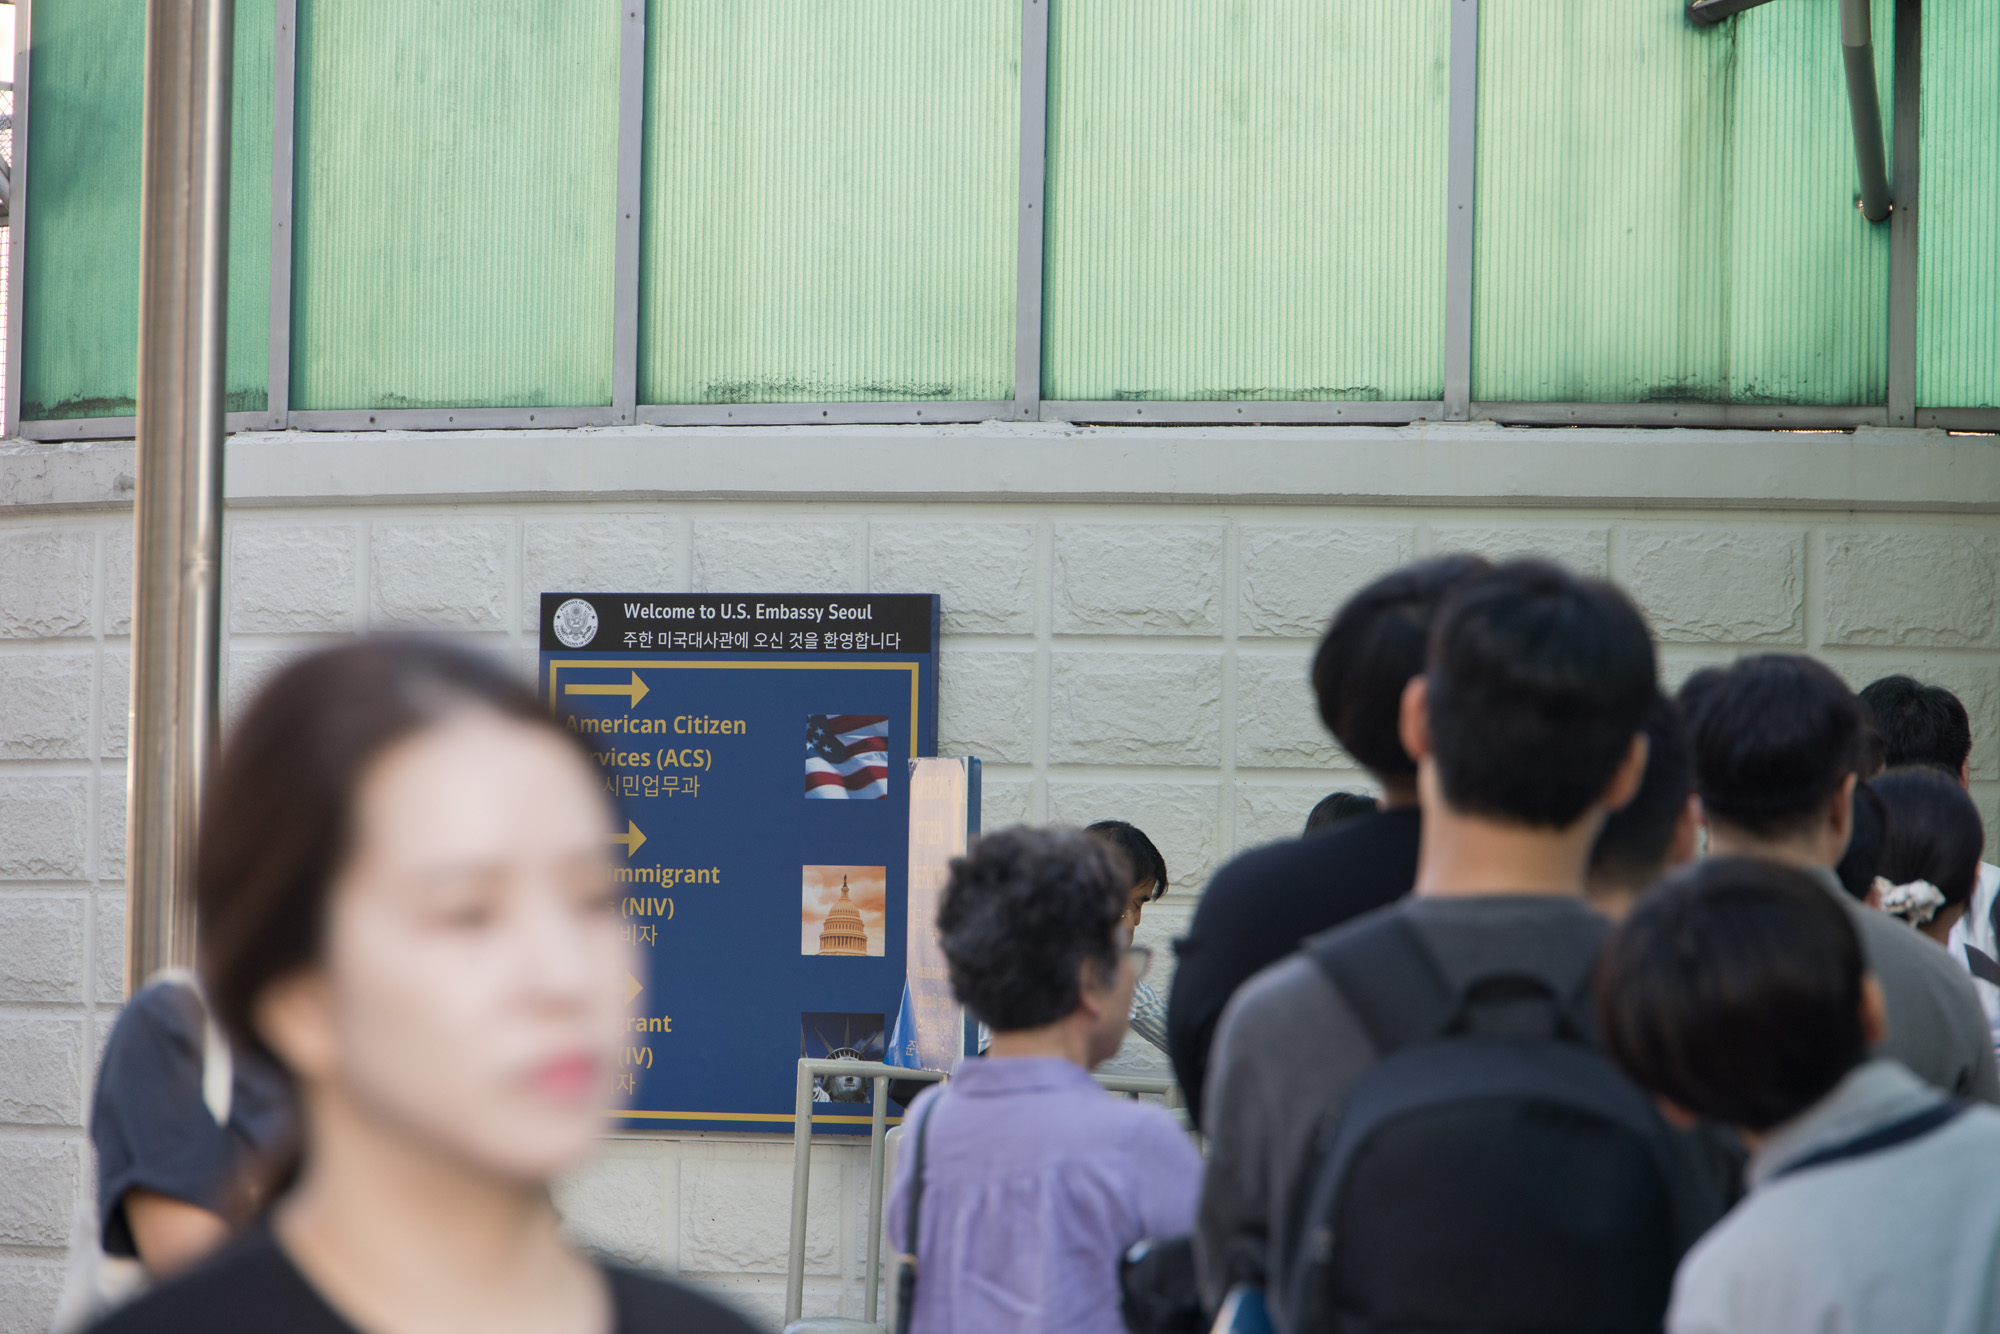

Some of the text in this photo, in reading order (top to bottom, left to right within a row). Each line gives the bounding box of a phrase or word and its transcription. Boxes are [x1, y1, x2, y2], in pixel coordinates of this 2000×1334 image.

[624, 603, 873, 623] Welcome to U.S. Embassy Seoul
[623, 631, 901, 650] 주한 미국대사관에 오신 것을 환영합니다
[565, 714, 746, 735] American Citizen
[590, 747, 712, 771] rvices (ACS)
[603, 774, 701, 798] 시민업무과
[621, 897, 674, 920] (NIV)
[619, 1046, 653, 1069] (IV)
